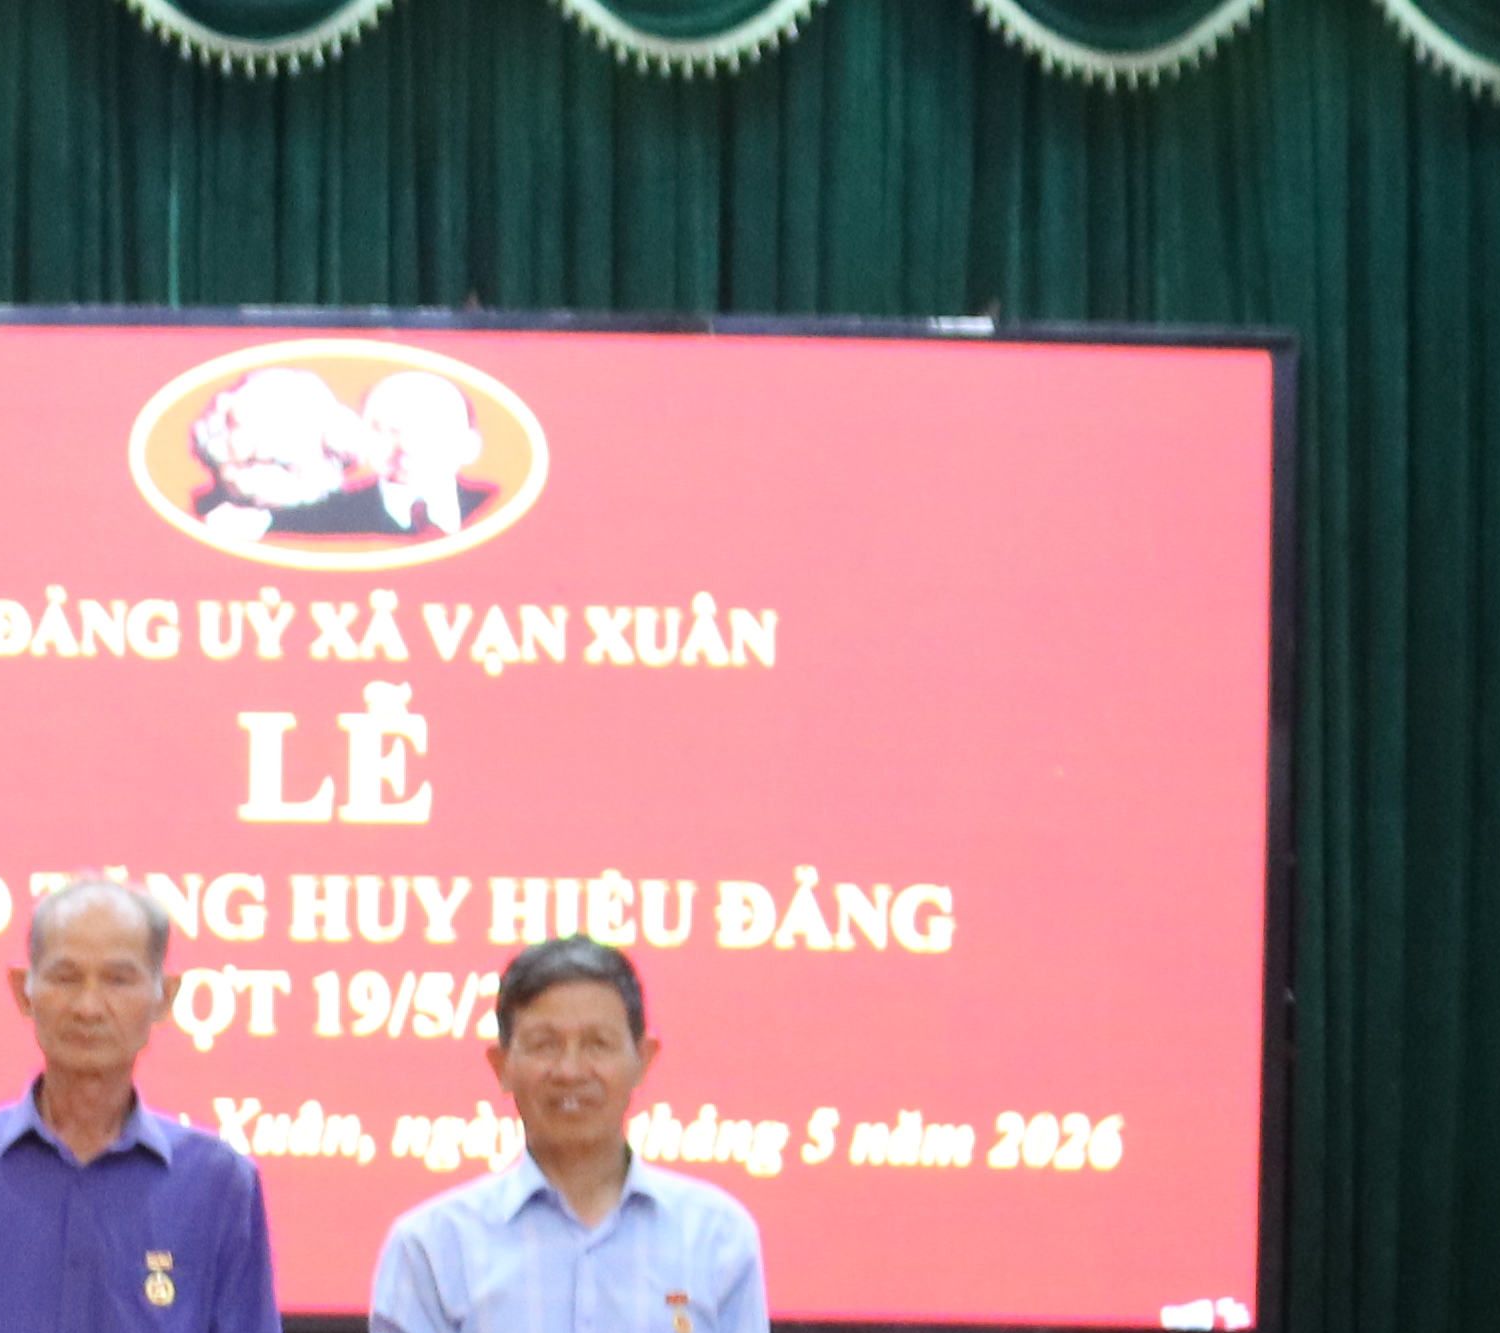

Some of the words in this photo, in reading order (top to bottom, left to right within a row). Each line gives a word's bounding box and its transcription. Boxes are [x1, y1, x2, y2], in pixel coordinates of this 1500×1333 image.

[307, 587, 411, 665] XÃ
[420, 600, 571, 679] VẠN
[581, 590, 781, 671] XUÂN
[234, 678, 435, 827] LỄ
[286, 873, 474, 945] HUY
[711, 862, 957, 956] ĐẢNG
[172, 962, 293, 1054] ỢT
[799, 1106, 842, 1167] 5
[847, 1107, 978, 1170] năm
[984, 1109, 1126, 1173] 2026
